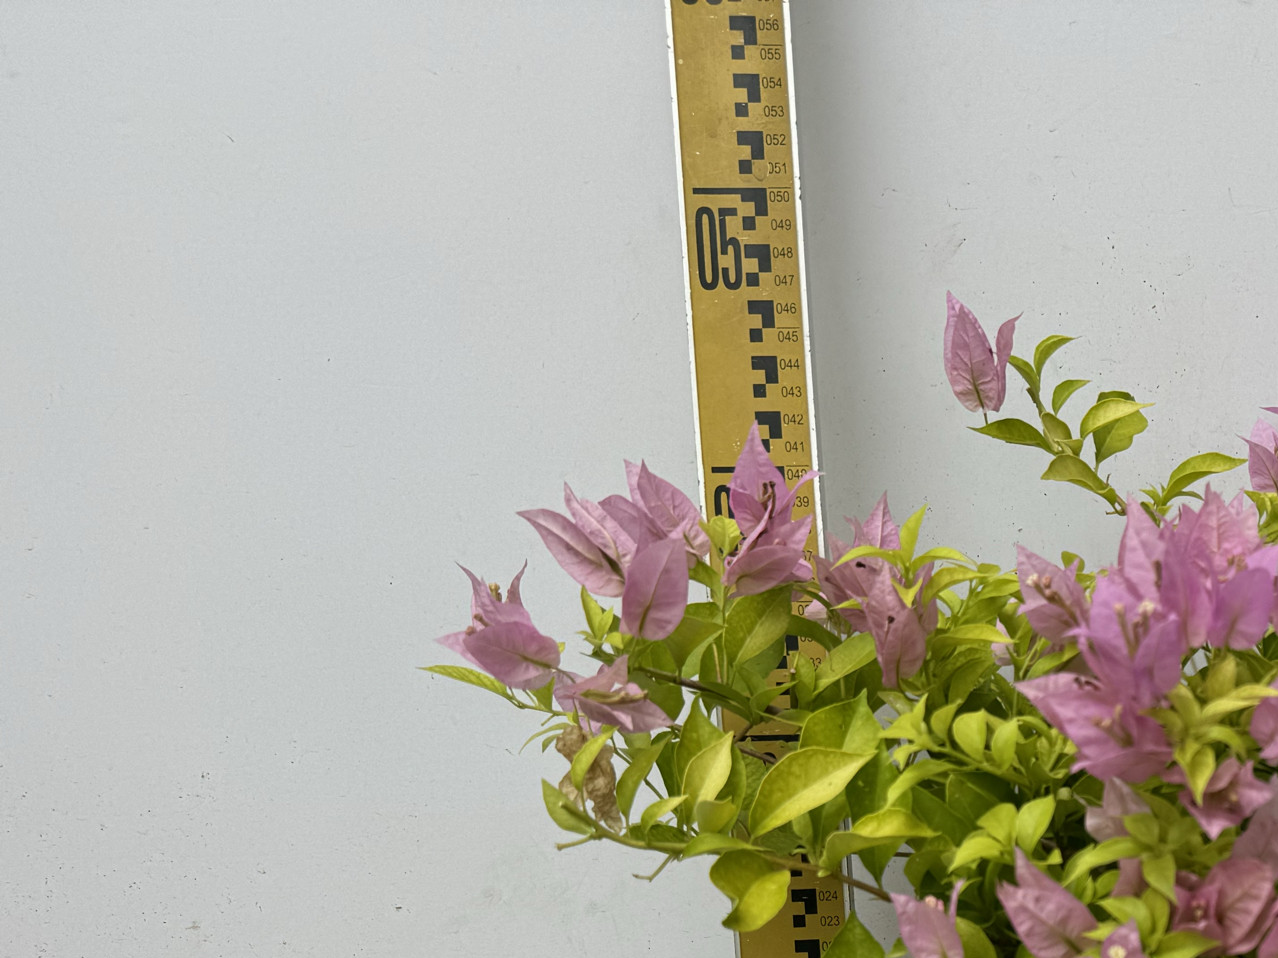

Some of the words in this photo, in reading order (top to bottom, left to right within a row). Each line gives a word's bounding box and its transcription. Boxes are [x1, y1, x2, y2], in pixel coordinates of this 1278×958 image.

[757, 19, 779, 31] 056
[760, 48, 781, 60] 055
[762, 77, 782, 88] 054
[764, 106, 784, 117] 053
[766, 134, 786, 145] 052
[769, 191, 789, 202] 050
[771, 219, 791, 230] 049
[695, 206, 742, 291] 05
[773, 247, 793, 258] 048
[775, 275, 794, 286] 047
[776, 303, 796, 314] 046
[778, 331, 798, 342] 045
[780, 359, 799, 370] 044
[782, 386, 801, 397] 043
[783, 414, 803, 425] 042
[785, 441, 804, 452] 041
[793, 496, 809, 507] 39
[819, 891, 837, 901] 024
[820, 916, 840, 926] 023
